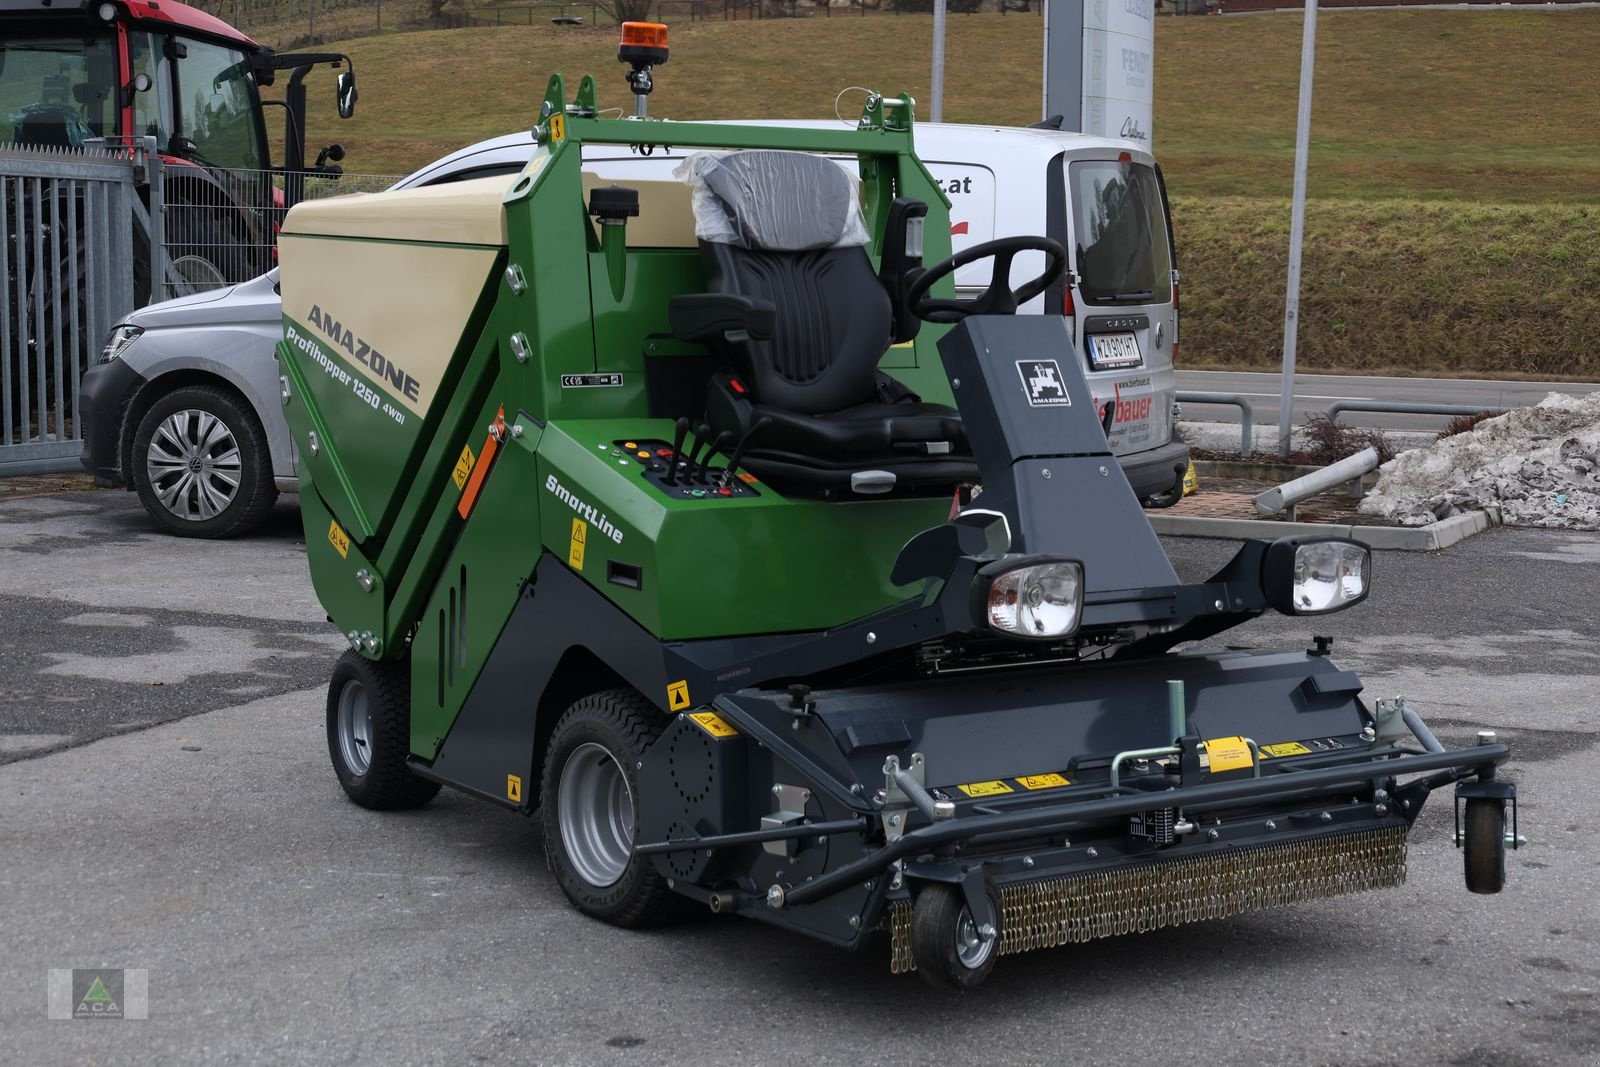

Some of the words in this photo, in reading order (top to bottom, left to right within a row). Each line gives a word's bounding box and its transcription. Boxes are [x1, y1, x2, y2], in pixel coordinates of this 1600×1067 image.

[1121, 48, 1150, 74] FENDT
[1095, 338, 1109, 359] WZ
[1110, 336, 1136, 357] 901HT
[1107, 319, 1139, 328] CADDY
[286, 326, 352, 385] Profihopper
[352, 378, 381, 410] 1250
[307, 304, 421, 404] AMAZONE
[545, 474, 624, 544] SmartLine
